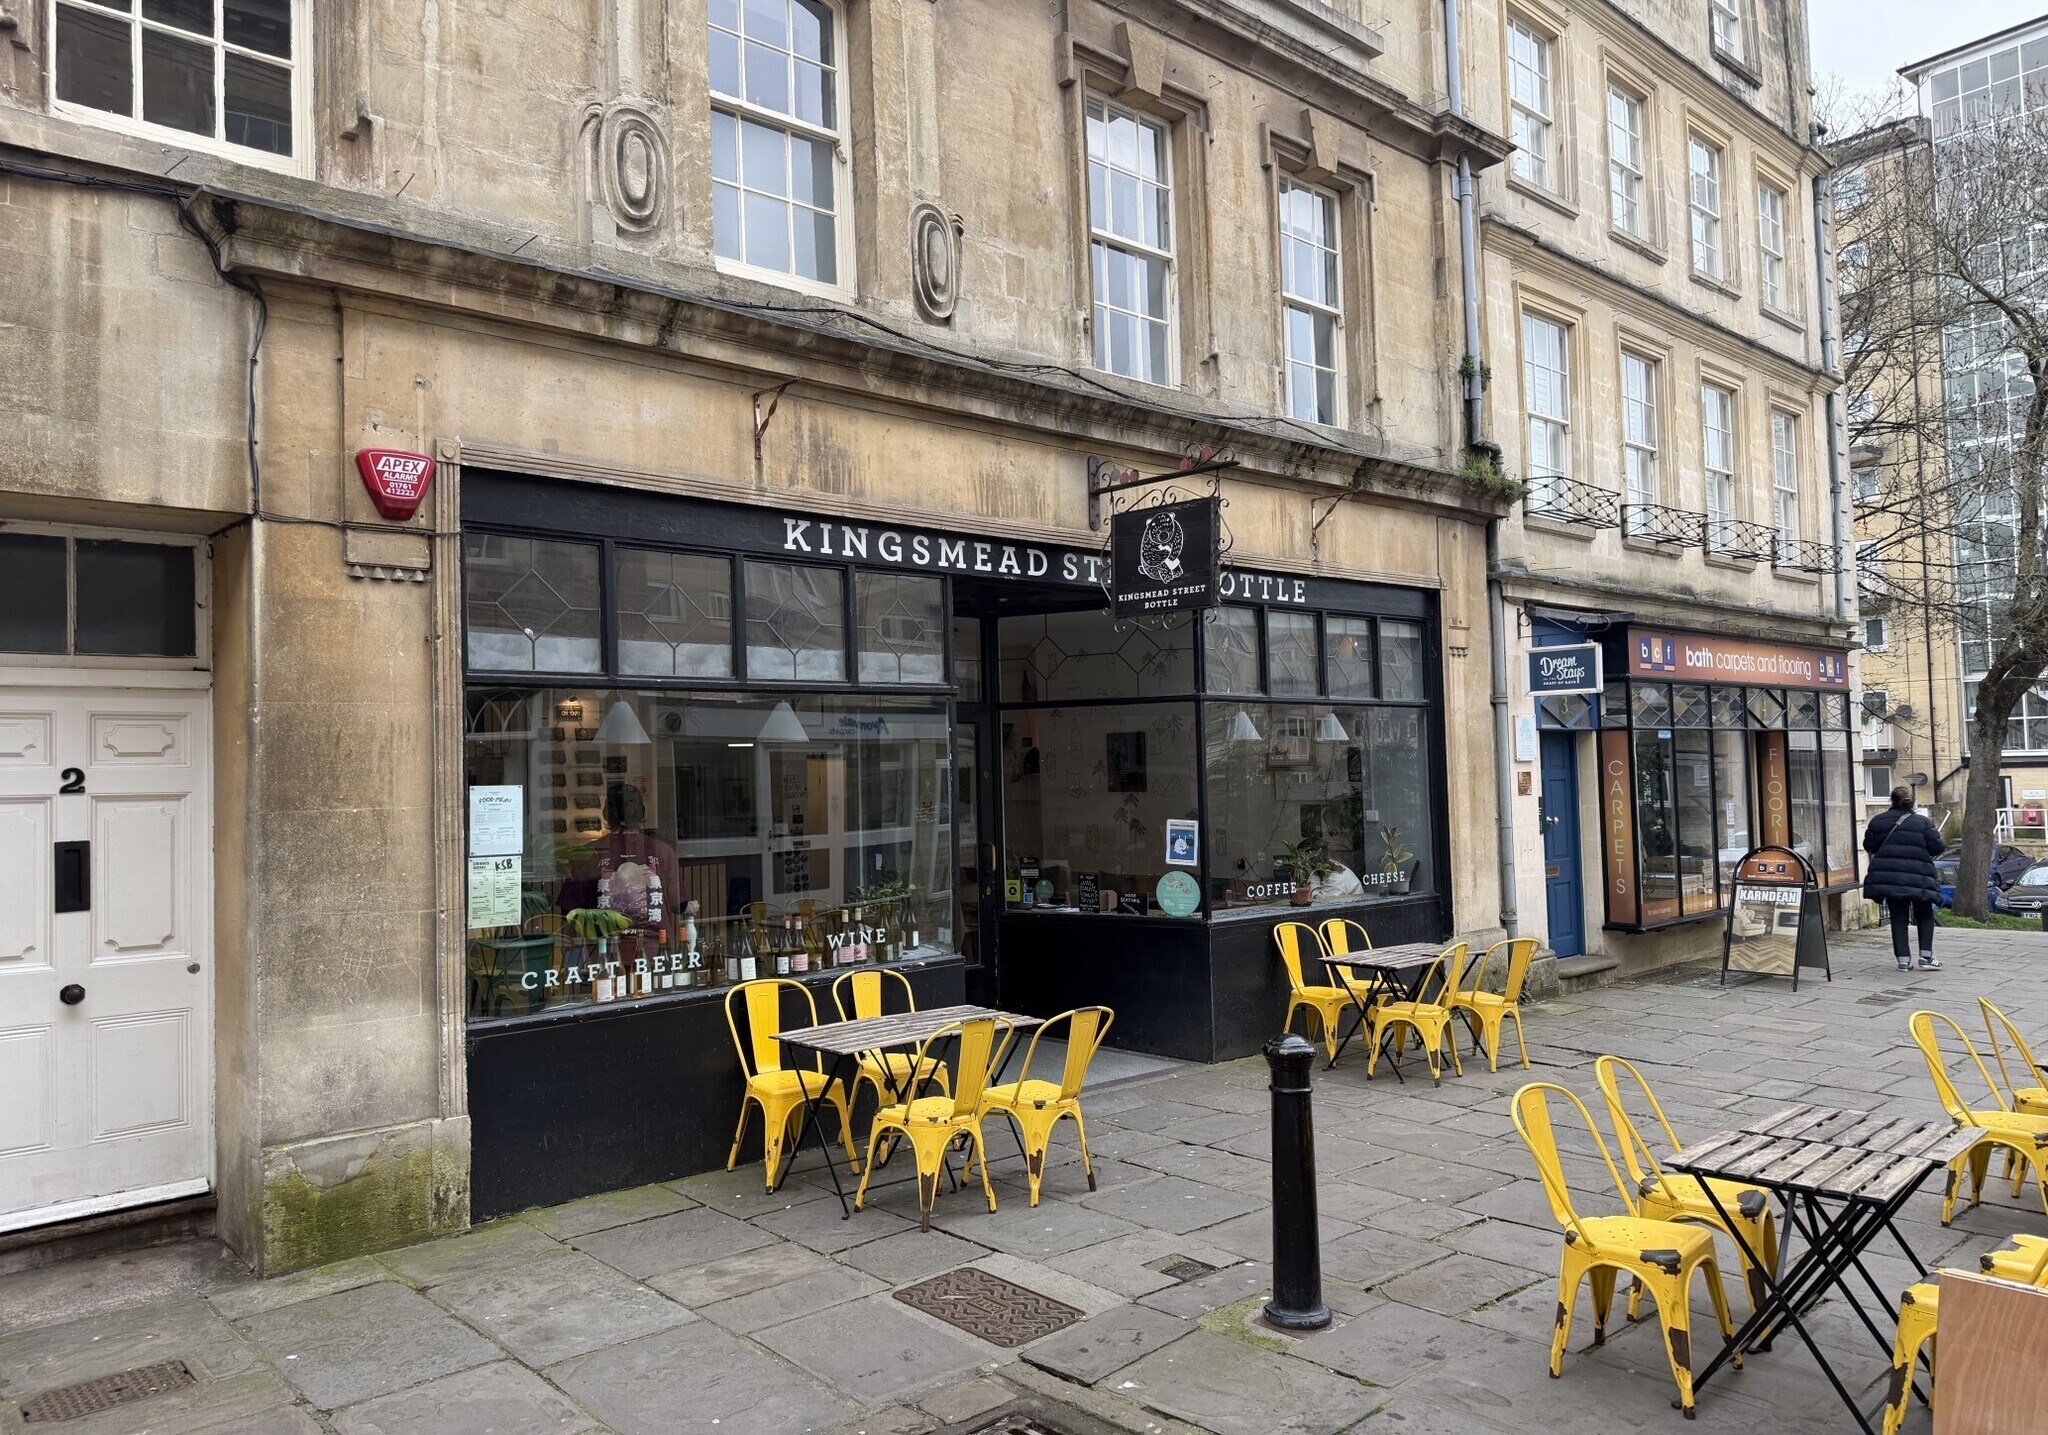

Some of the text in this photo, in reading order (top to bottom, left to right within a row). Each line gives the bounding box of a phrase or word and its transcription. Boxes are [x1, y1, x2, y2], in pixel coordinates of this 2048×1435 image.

[381, 458, 421, 474] APEX
[383, 472, 418, 482] ALARMS
[385, 488, 415, 497] 412222
[389, 482, 412, 490] 01761
[783, 517, 1048, 577] KINGSMEAD
[1219, 571, 1306, 603] OTTLE
[1118, 584, 1206, 602] KINGSMEAD STREET
[1144, 598, 1178, 609] BOTTLE
[1540, 656, 1578, 676] Dream
[1686, 646, 1811, 680] bath carpets and flooring
[1556, 667, 1585, 684] Stays
[1561, 696, 1569, 715] 3
[59, 767, 86, 794] 2
[1767, 748, 1783, 844] FLOORI
[1608, 760, 1626, 894] CARPETS
[495, 858, 513, 871] KSB
[1363, 871, 1405, 886] CHEESE
[1247, 882, 1297, 898] COFFEE
[1739, 889, 1797, 903] KARNDEAN
[826, 928, 886, 950] WINE
[521, 952, 702, 990] CRAFT BEER
